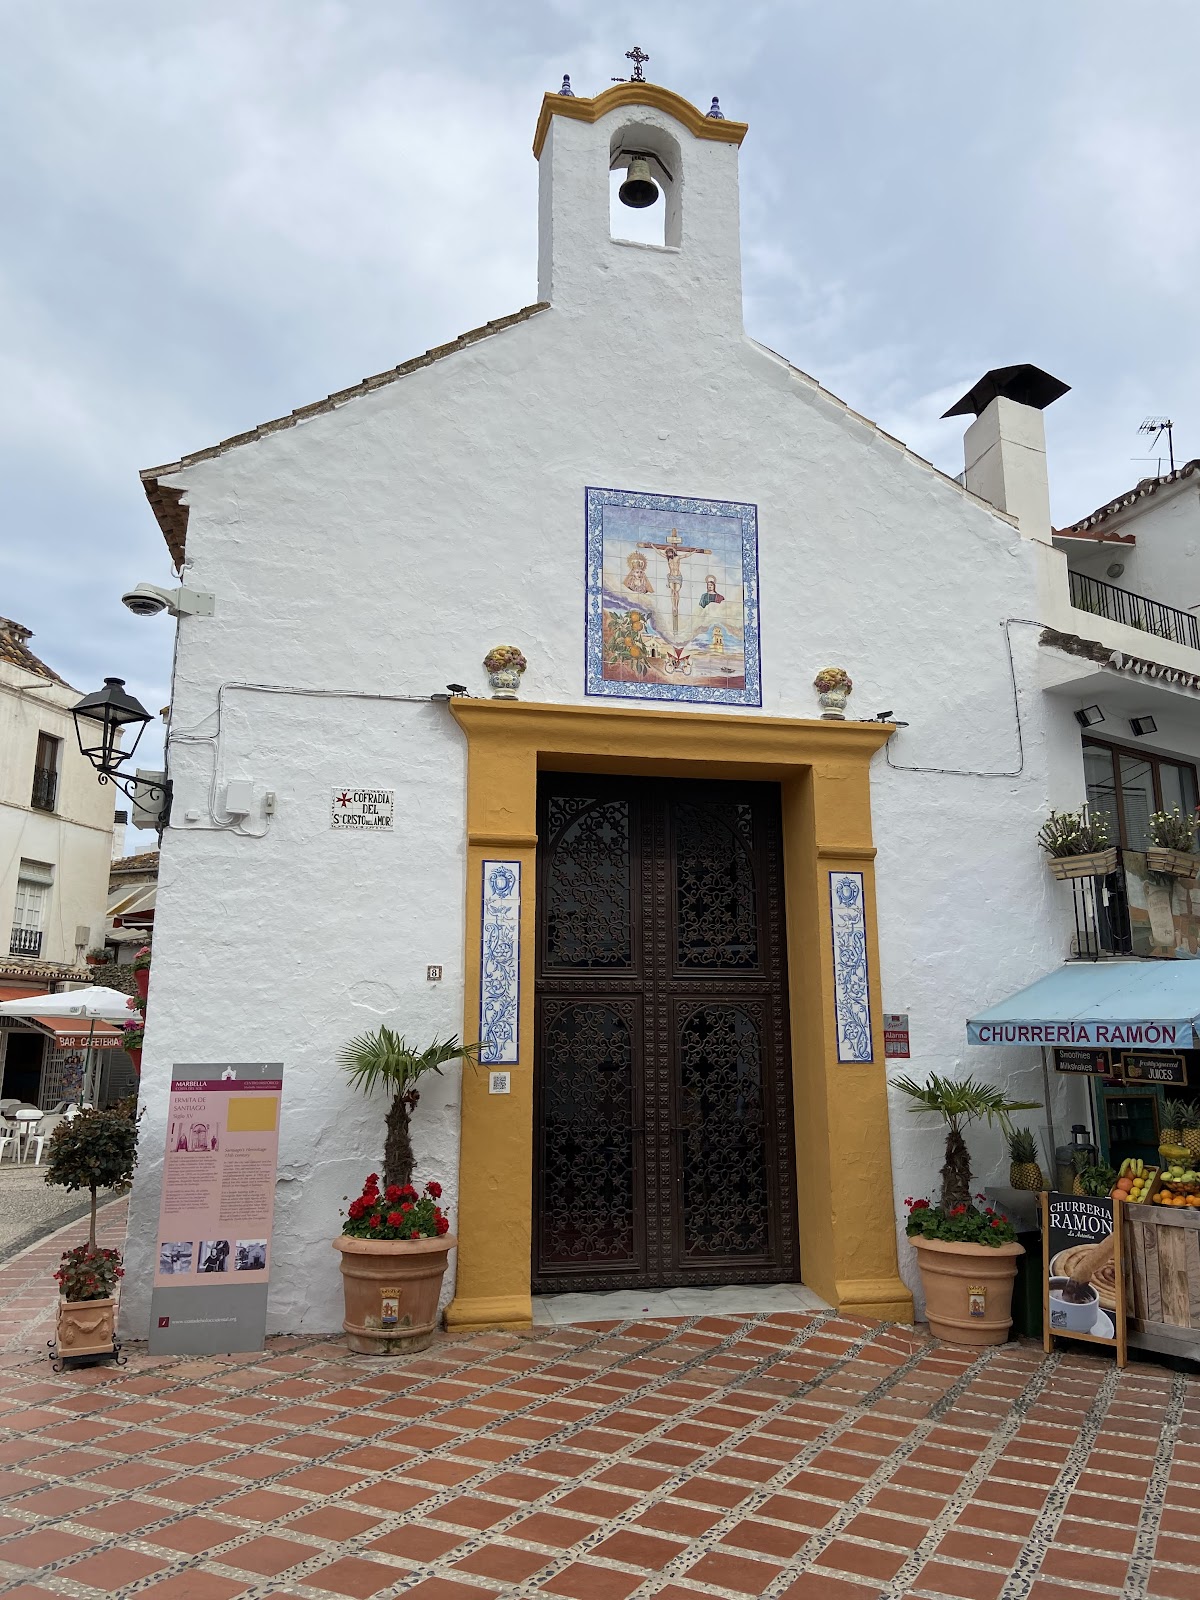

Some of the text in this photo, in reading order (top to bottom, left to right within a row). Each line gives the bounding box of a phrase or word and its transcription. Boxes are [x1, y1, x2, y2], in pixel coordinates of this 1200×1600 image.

[354, 792, 390, 804] COFRADIA
[362, 803, 379, 814] DEL
[342, 814, 366, 826] CRISTO
[373, 815, 391, 826] AMOR
[979, 1022, 1177, 1044] CHURRERÍA RAMÓN
[59, 1037, 120, 1047] BAR CAFETERIA
[1059, 1050, 1091, 1060] Smoothies
[1060, 1062, 1093, 1072] Milkshakes
[1148, 1068, 1174, 1081] JUICES
[1050, 1201, 1113, 1220] CHURRERIA
[1050, 1213, 1114, 1235] RAMON
